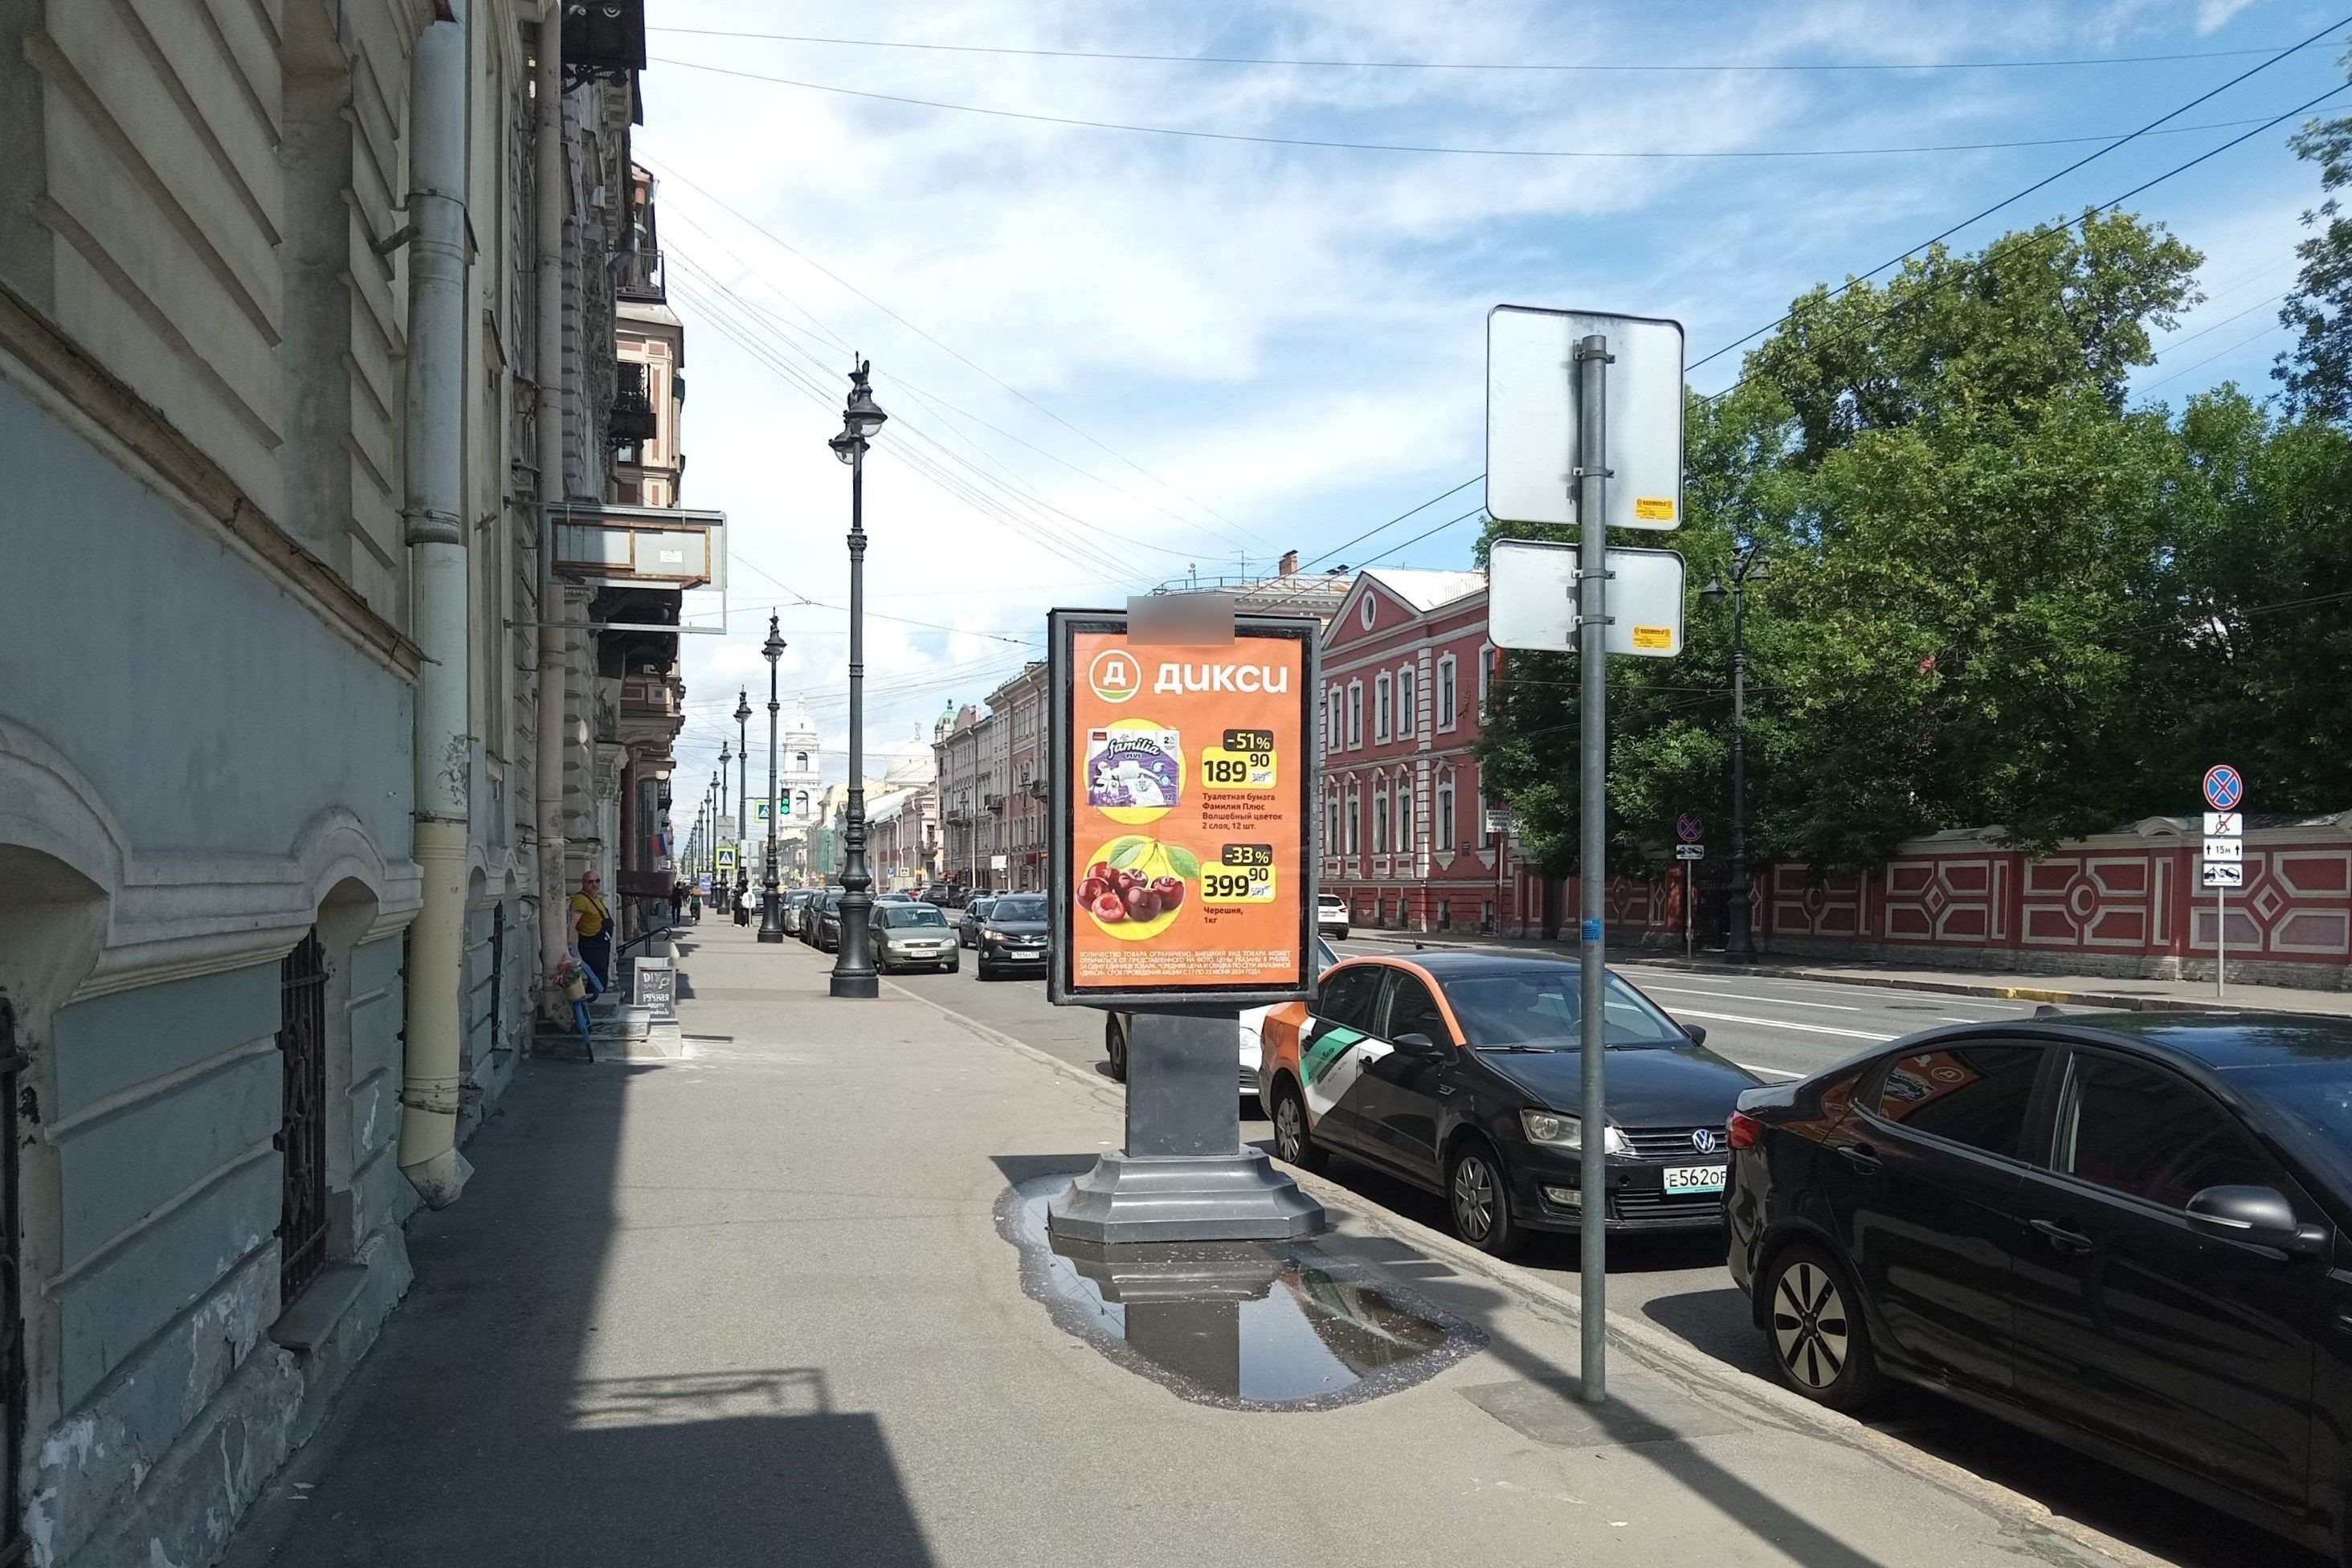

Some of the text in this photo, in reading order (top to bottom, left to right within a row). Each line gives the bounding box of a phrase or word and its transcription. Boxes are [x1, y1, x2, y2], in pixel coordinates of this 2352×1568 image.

[1103, 661, 1126, 687] Д
[1108, 737, 1160, 759] familia
[1227, 733, 1271, 749] -51%
[1204, 753, 1270, 782] 189 90
[1203, 793, 1276, 802] Туалетная бумага
[1225, 847, 1269, 864] -33%
[1203, 868, 1269, 896] 399 90
[1203, 907, 1243, 915] Черешня,
